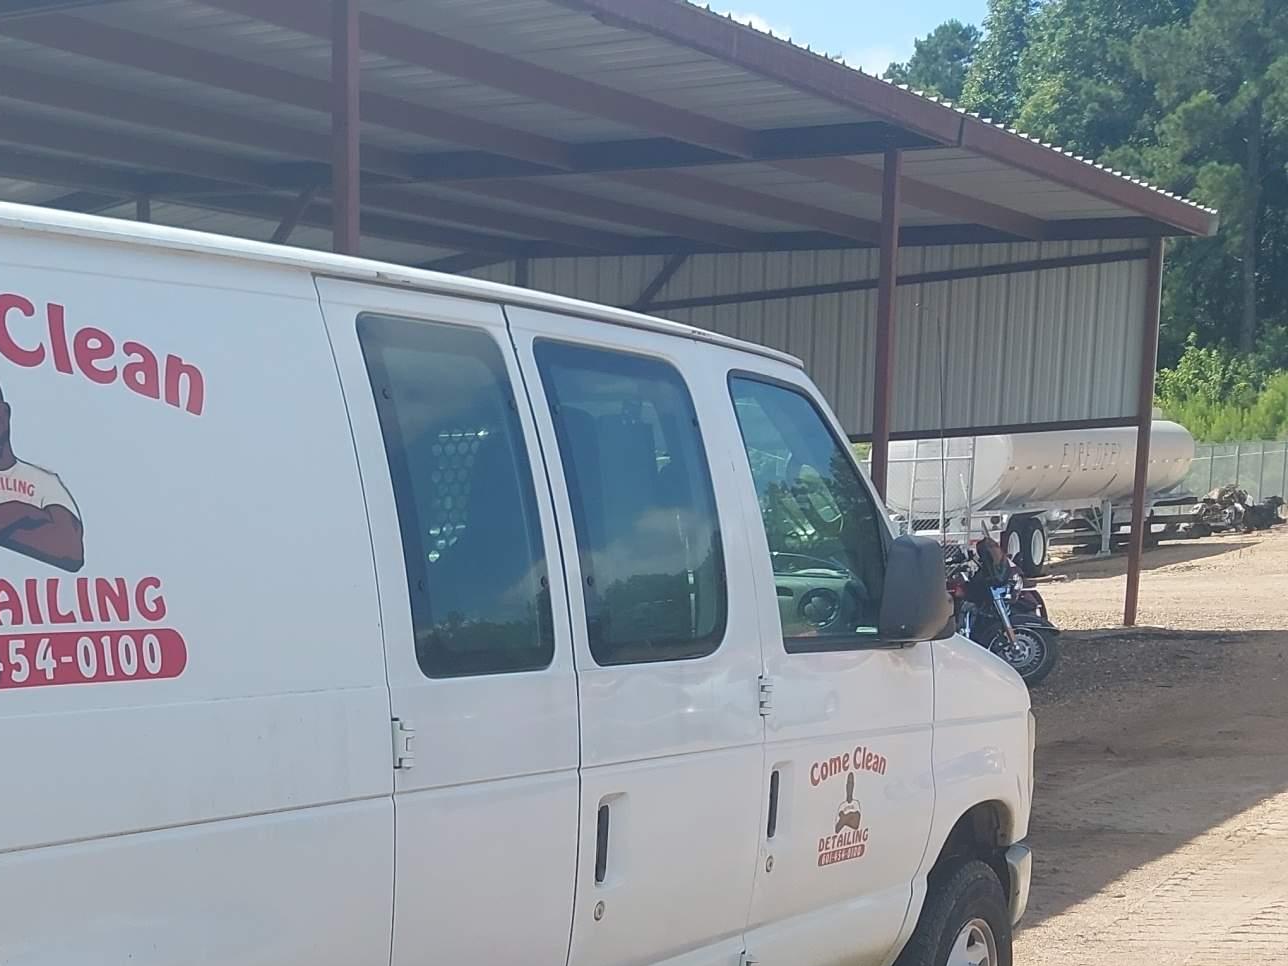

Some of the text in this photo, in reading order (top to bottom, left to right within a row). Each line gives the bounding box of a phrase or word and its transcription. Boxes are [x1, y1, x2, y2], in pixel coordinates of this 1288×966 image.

[810, 746, 887, 787] Come Clean
[818, 828, 869, 852] DETAILING
